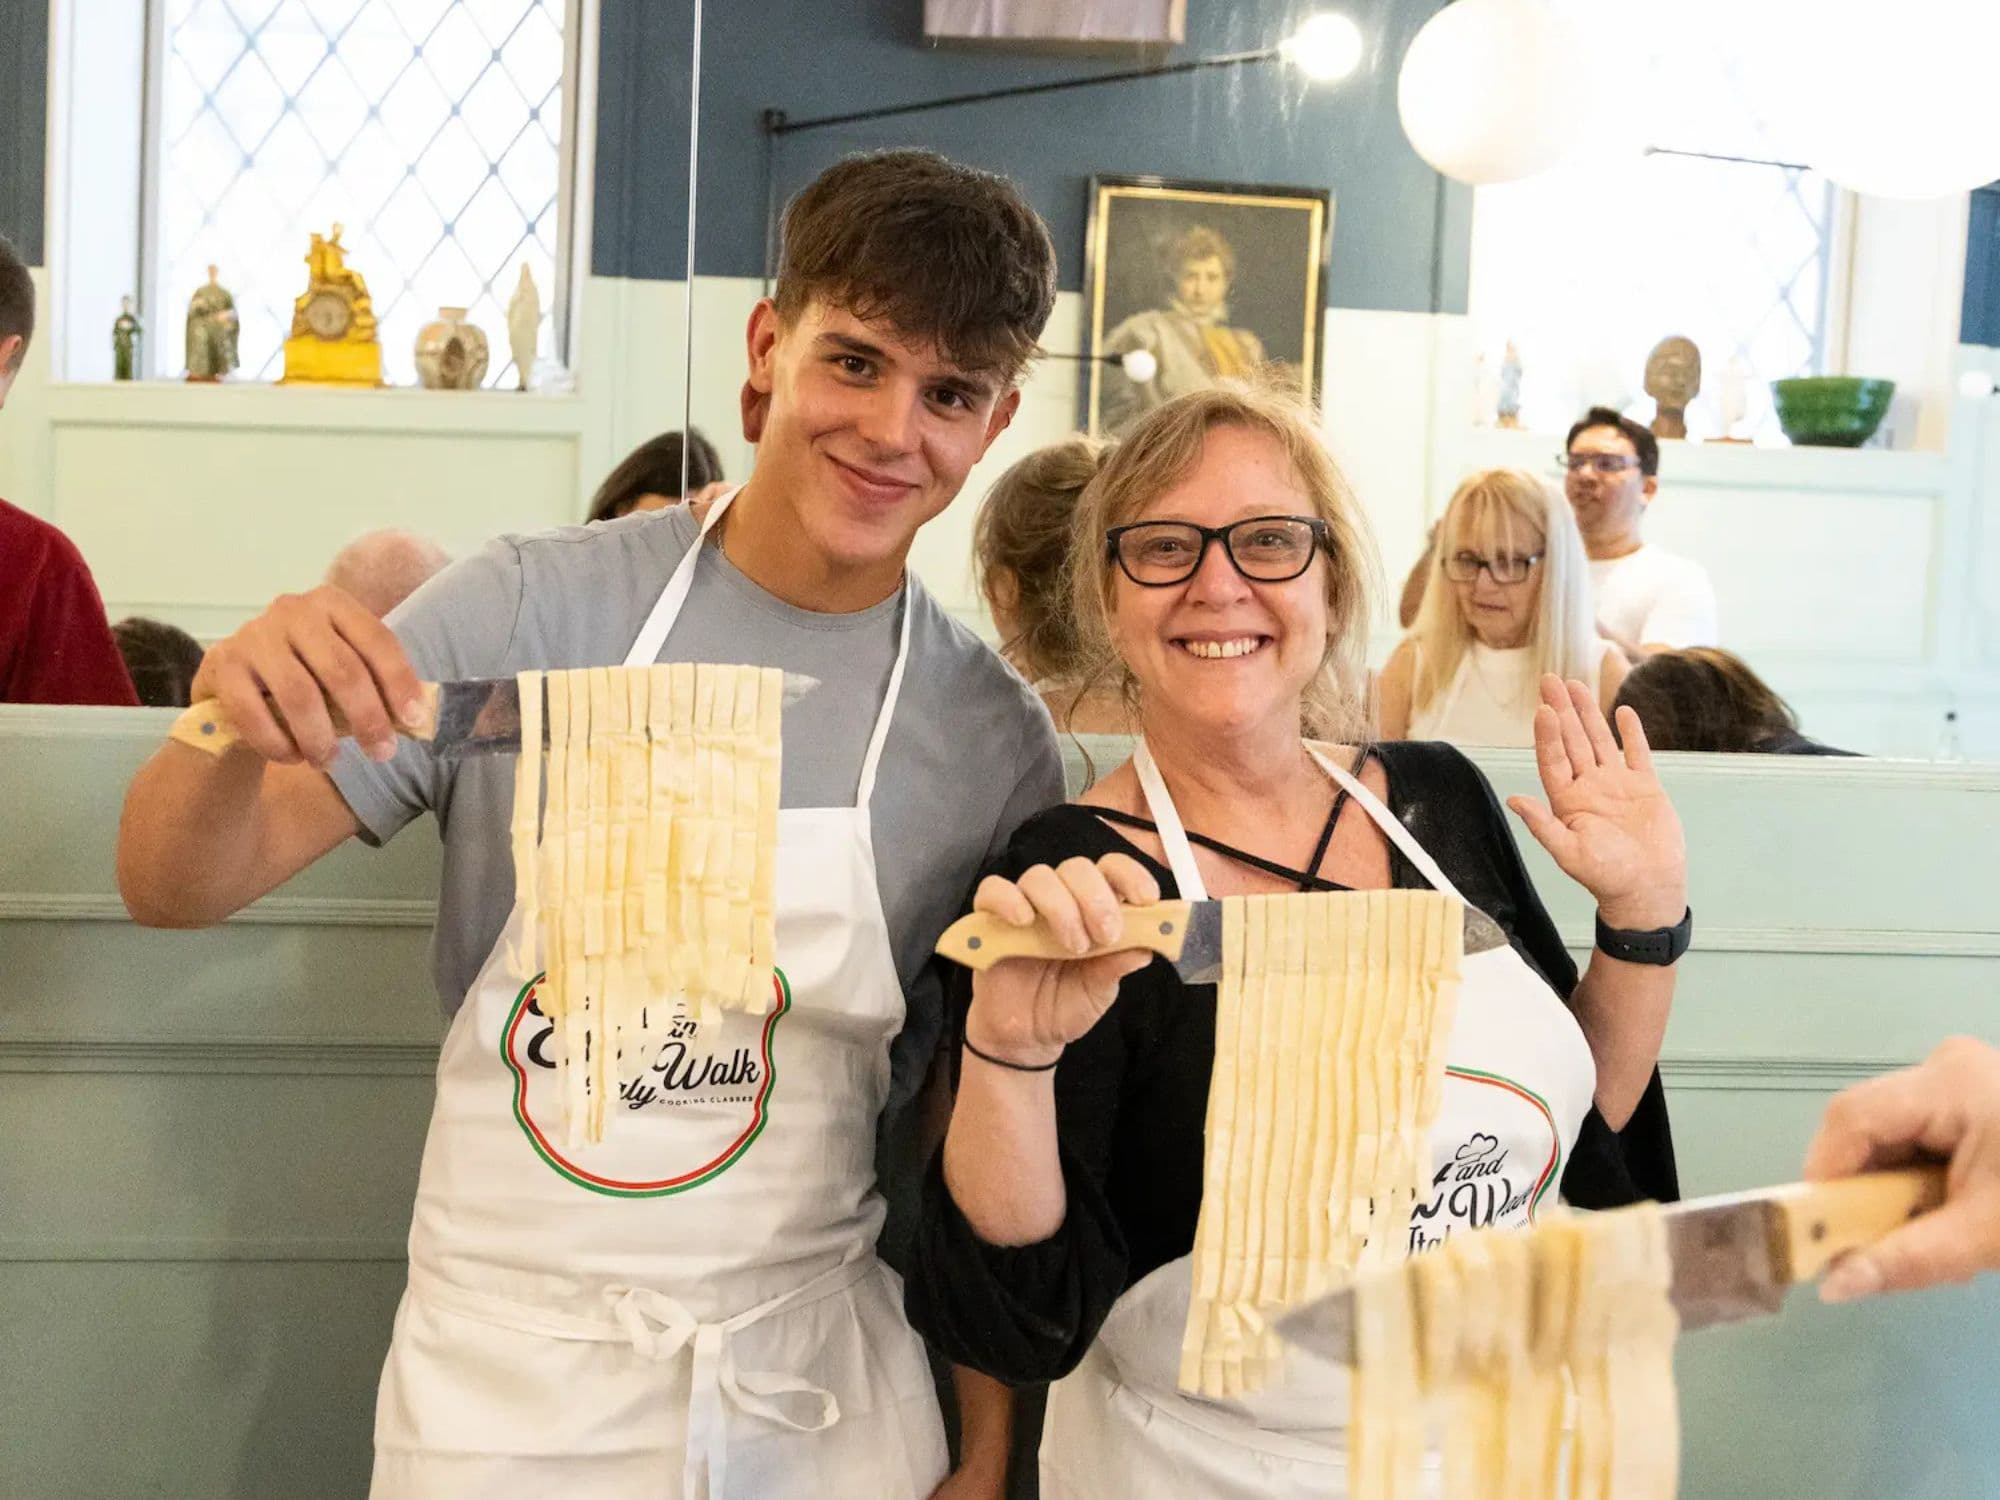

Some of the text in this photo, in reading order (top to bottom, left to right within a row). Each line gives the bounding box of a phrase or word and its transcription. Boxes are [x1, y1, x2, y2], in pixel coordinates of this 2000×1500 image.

[651, 1042, 760, 1091] Walk
[659, 1097, 705, 1107] COOKING
[1455, 1149, 1509, 1182] and
